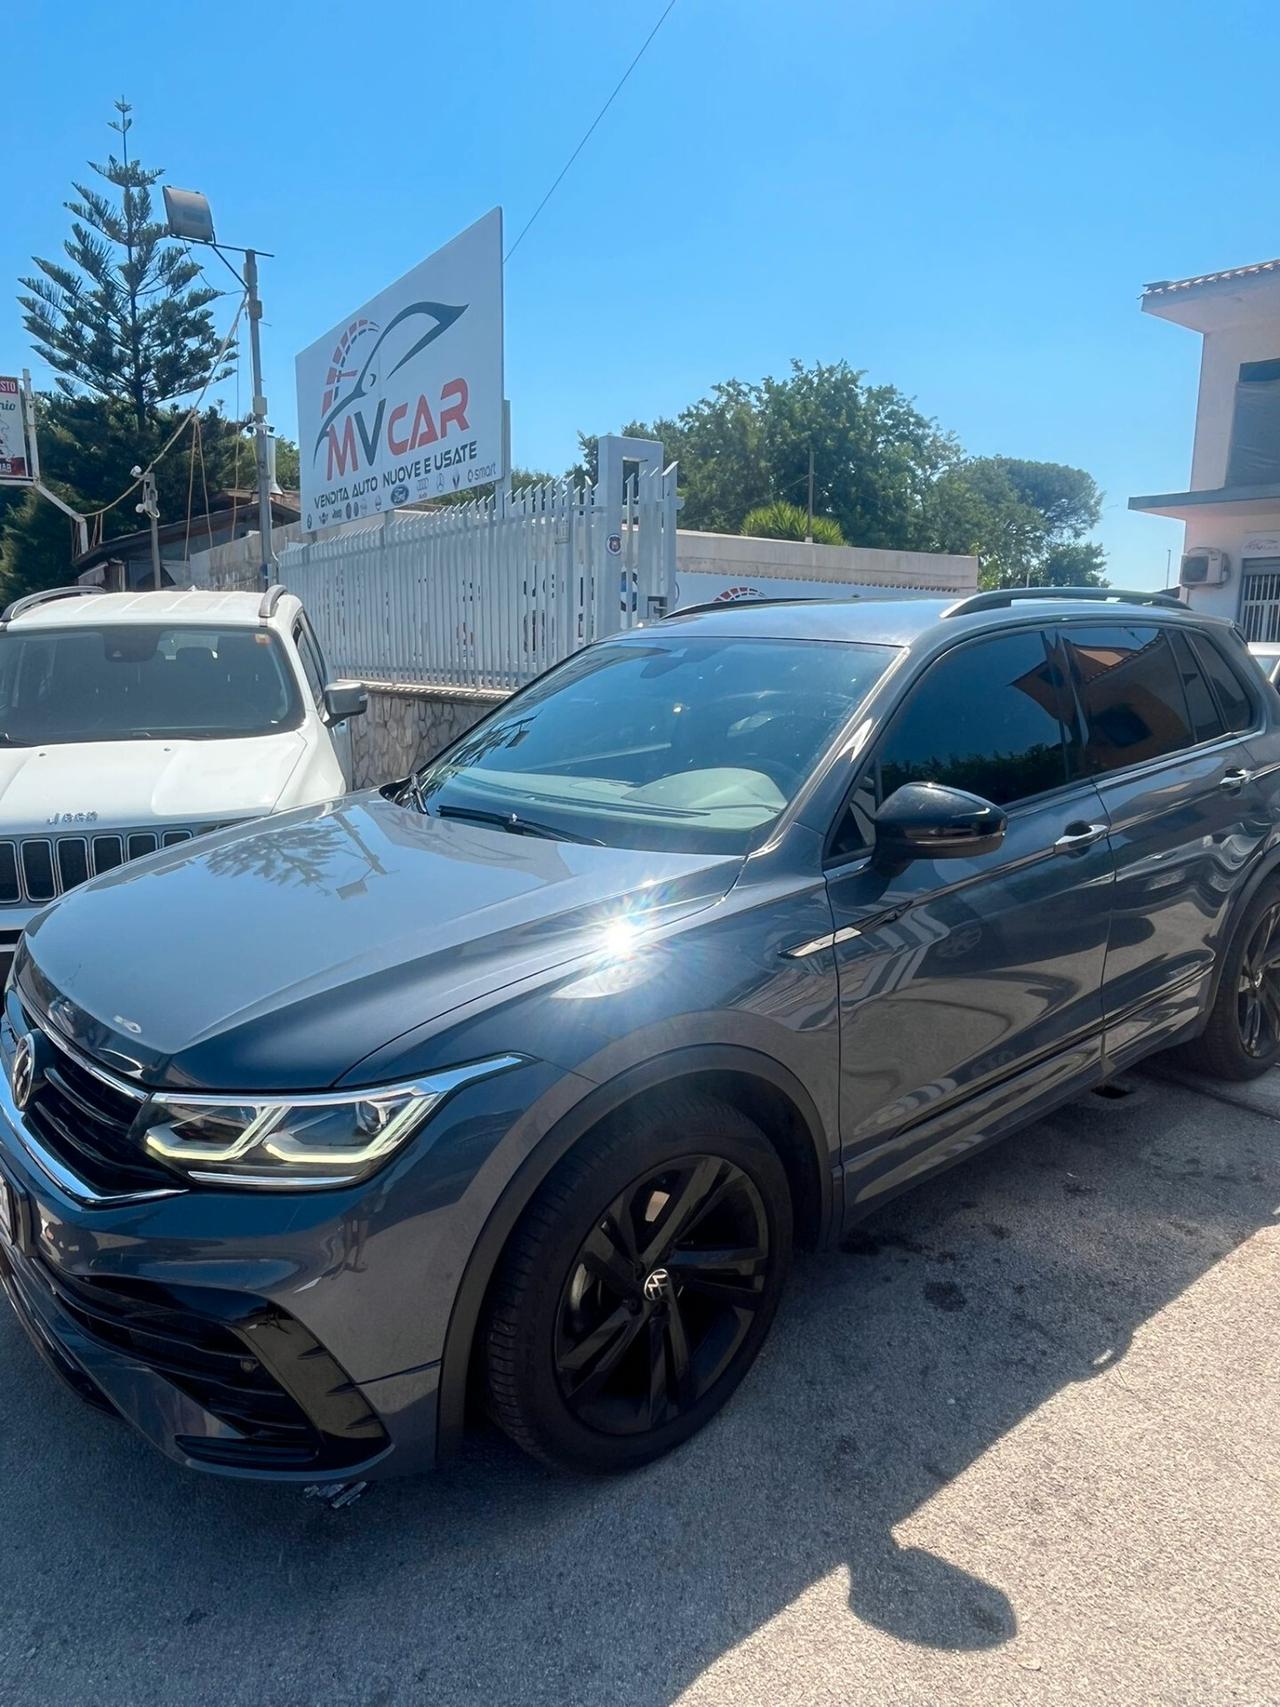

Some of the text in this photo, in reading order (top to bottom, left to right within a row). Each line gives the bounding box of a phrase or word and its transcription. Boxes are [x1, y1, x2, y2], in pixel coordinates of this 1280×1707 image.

[314, 487, 350, 509] VENDITA
[352, 476, 378, 498] AUTO
[383, 460, 421, 488] NUOVE
[424, 457, 431, 474] E
[434, 441, 478, 471] USATE
[474, 462, 496, 480] smart
